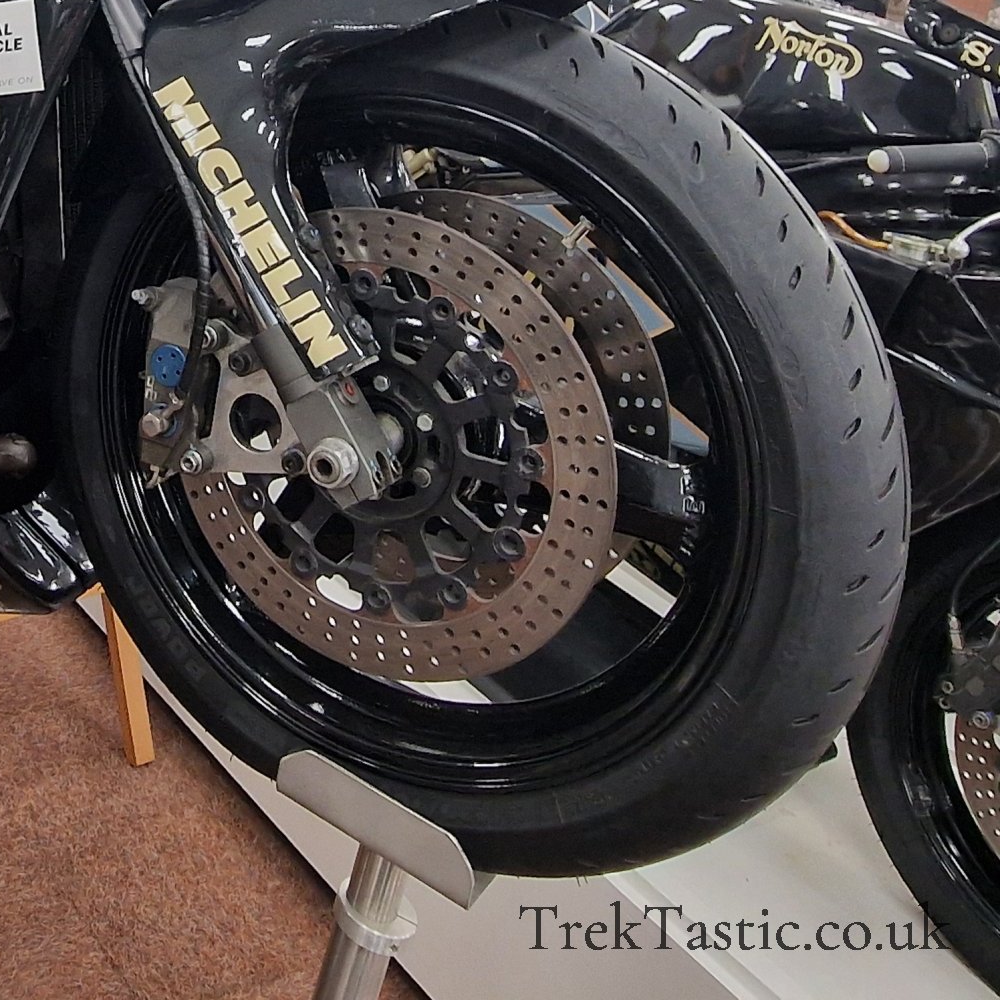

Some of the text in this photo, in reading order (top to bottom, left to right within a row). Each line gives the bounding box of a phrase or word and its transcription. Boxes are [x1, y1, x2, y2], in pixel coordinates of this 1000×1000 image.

[18, 75, 34, 85] ON
[755, 16, 863, 80] Norton
[153, 76, 348, 368] MICHELIN
